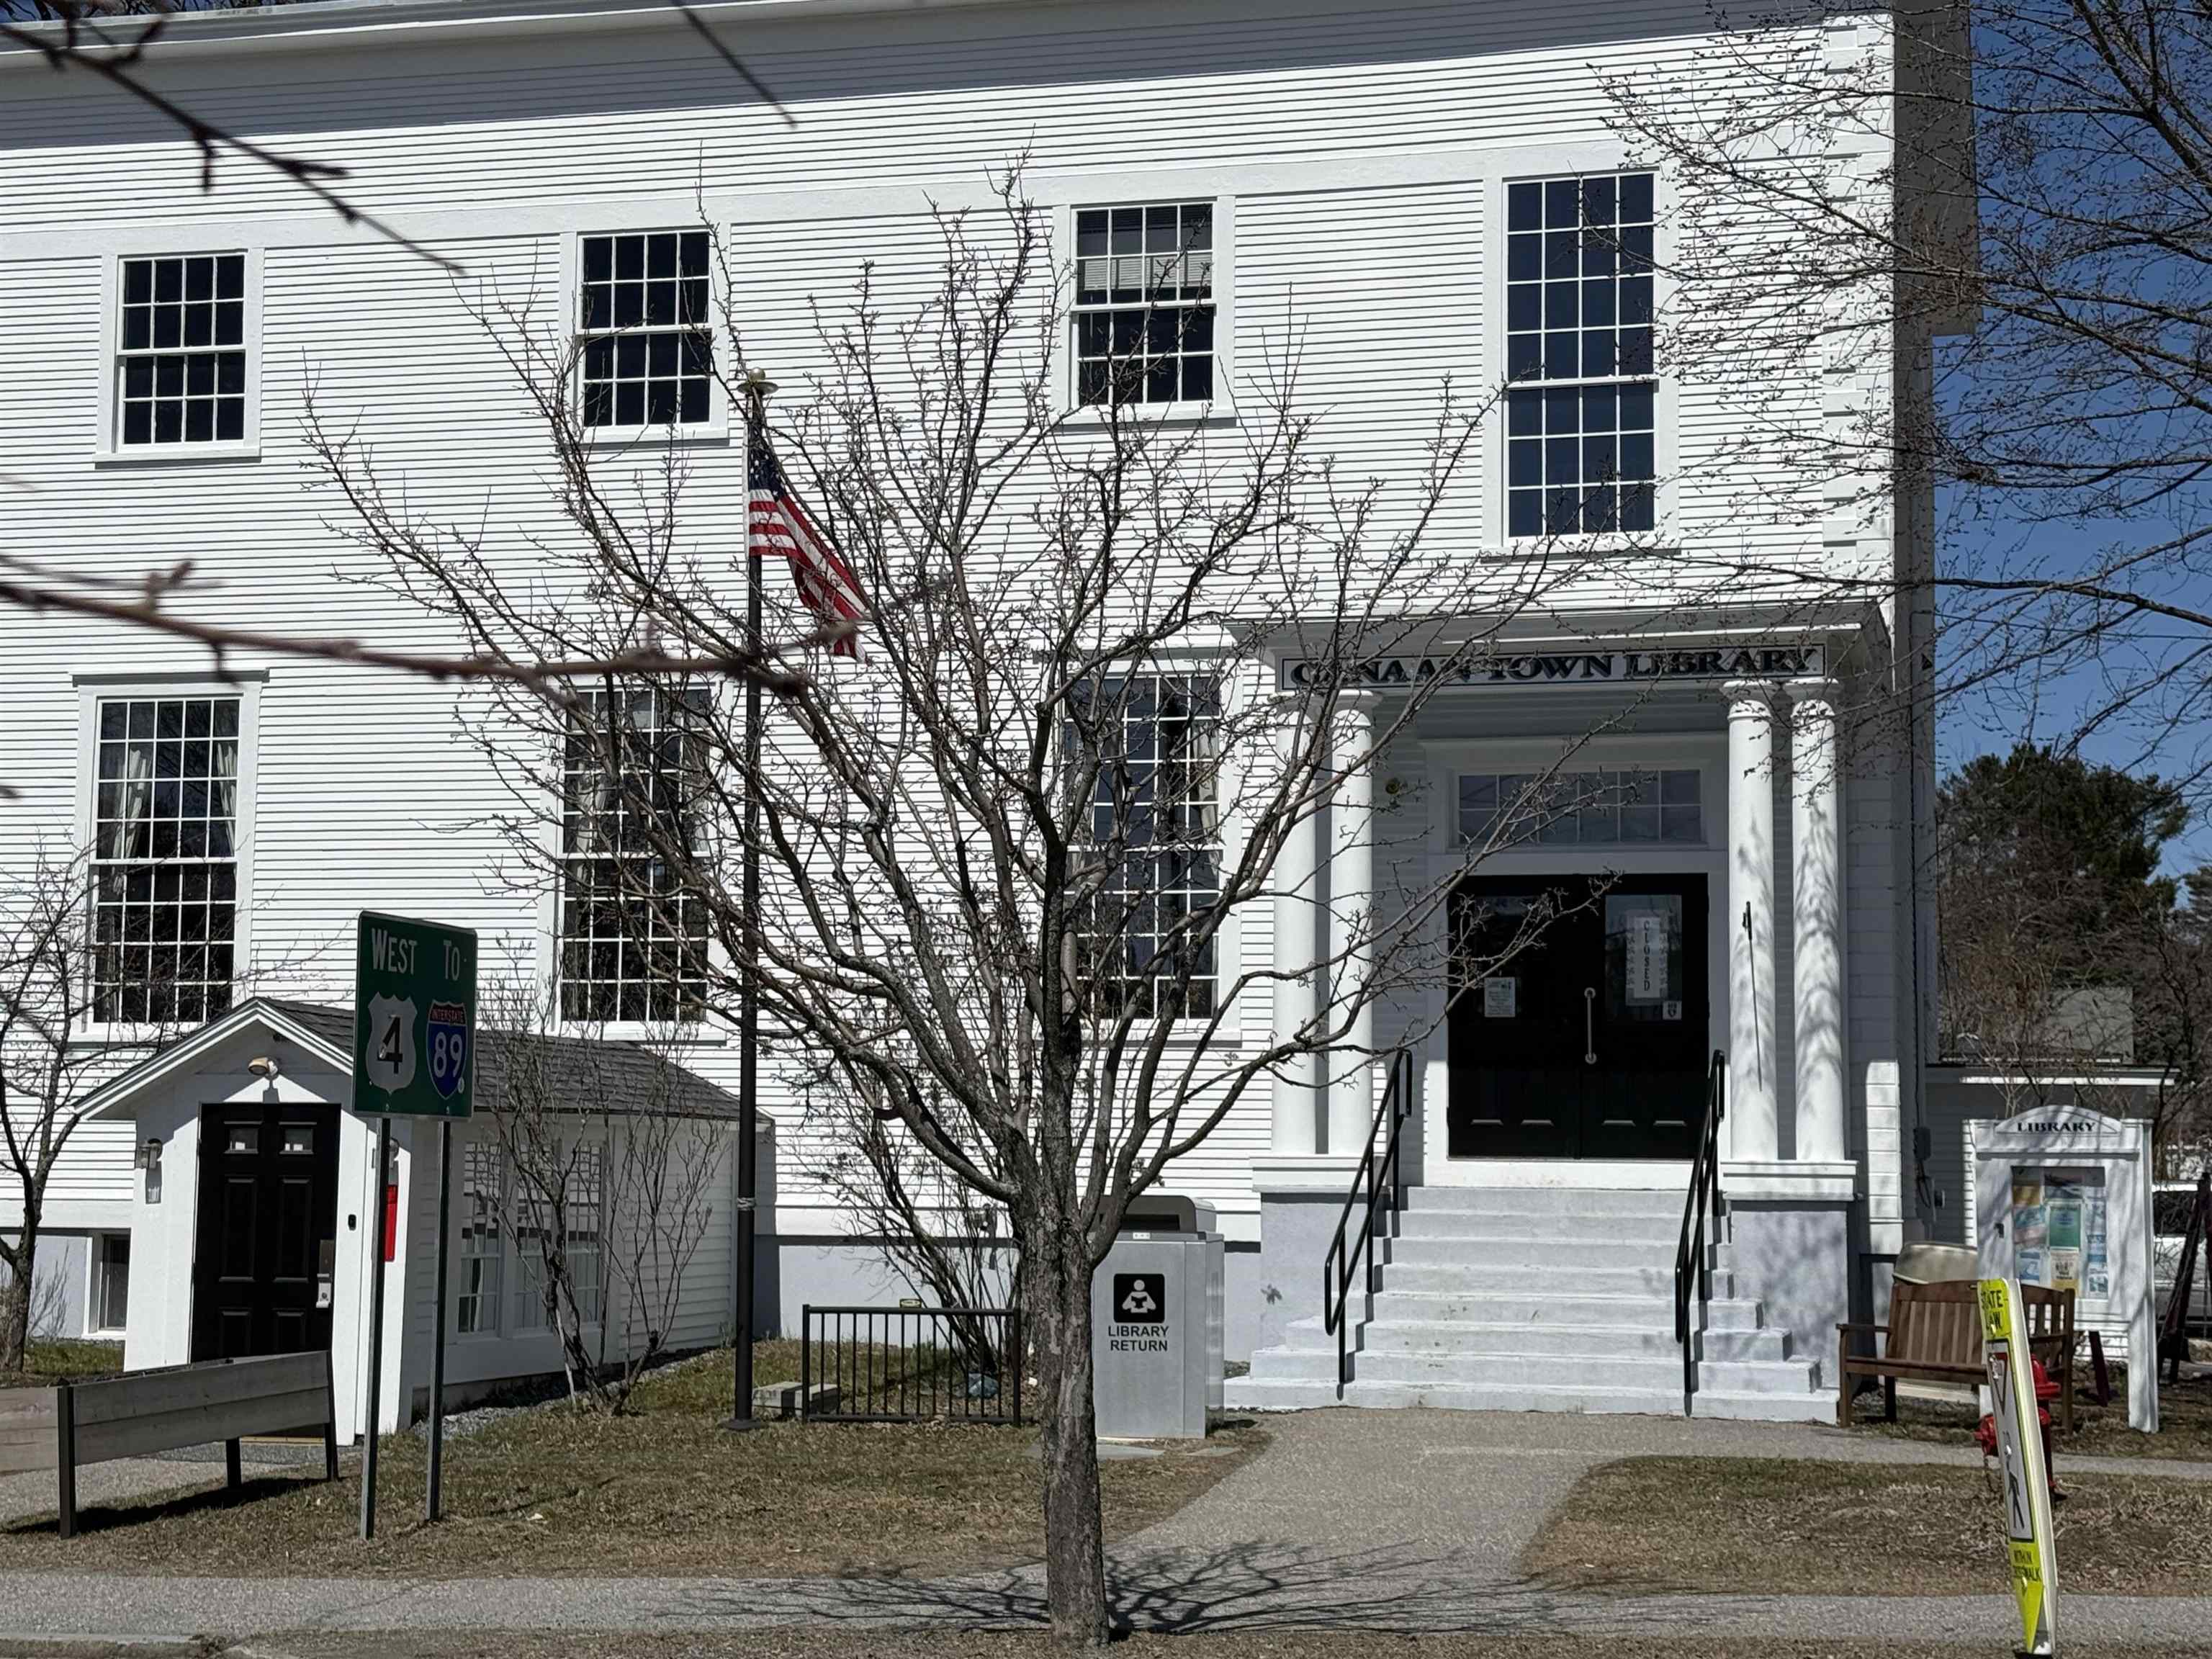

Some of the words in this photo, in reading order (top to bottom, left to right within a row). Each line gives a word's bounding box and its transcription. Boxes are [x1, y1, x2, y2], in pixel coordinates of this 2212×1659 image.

[1291, 658, 1473, 685] CNAA
[1483, 654, 1614, 680] TOWN
[1622, 649, 1816, 677] LIBRARY
[372, 928, 418, 974] WEST
[444, 940, 459, 981] TO
[432, 1008, 464, 1023] INTERSTATE
[378, 1016, 403, 1074] 4
[433, 1032, 462, 1077] 89
[2018, 1122, 2095, 1132] LIBRARY
[1108, 1326, 1169, 1337] LIBRARY
[1110, 1340, 1167, 1351] RETURN
